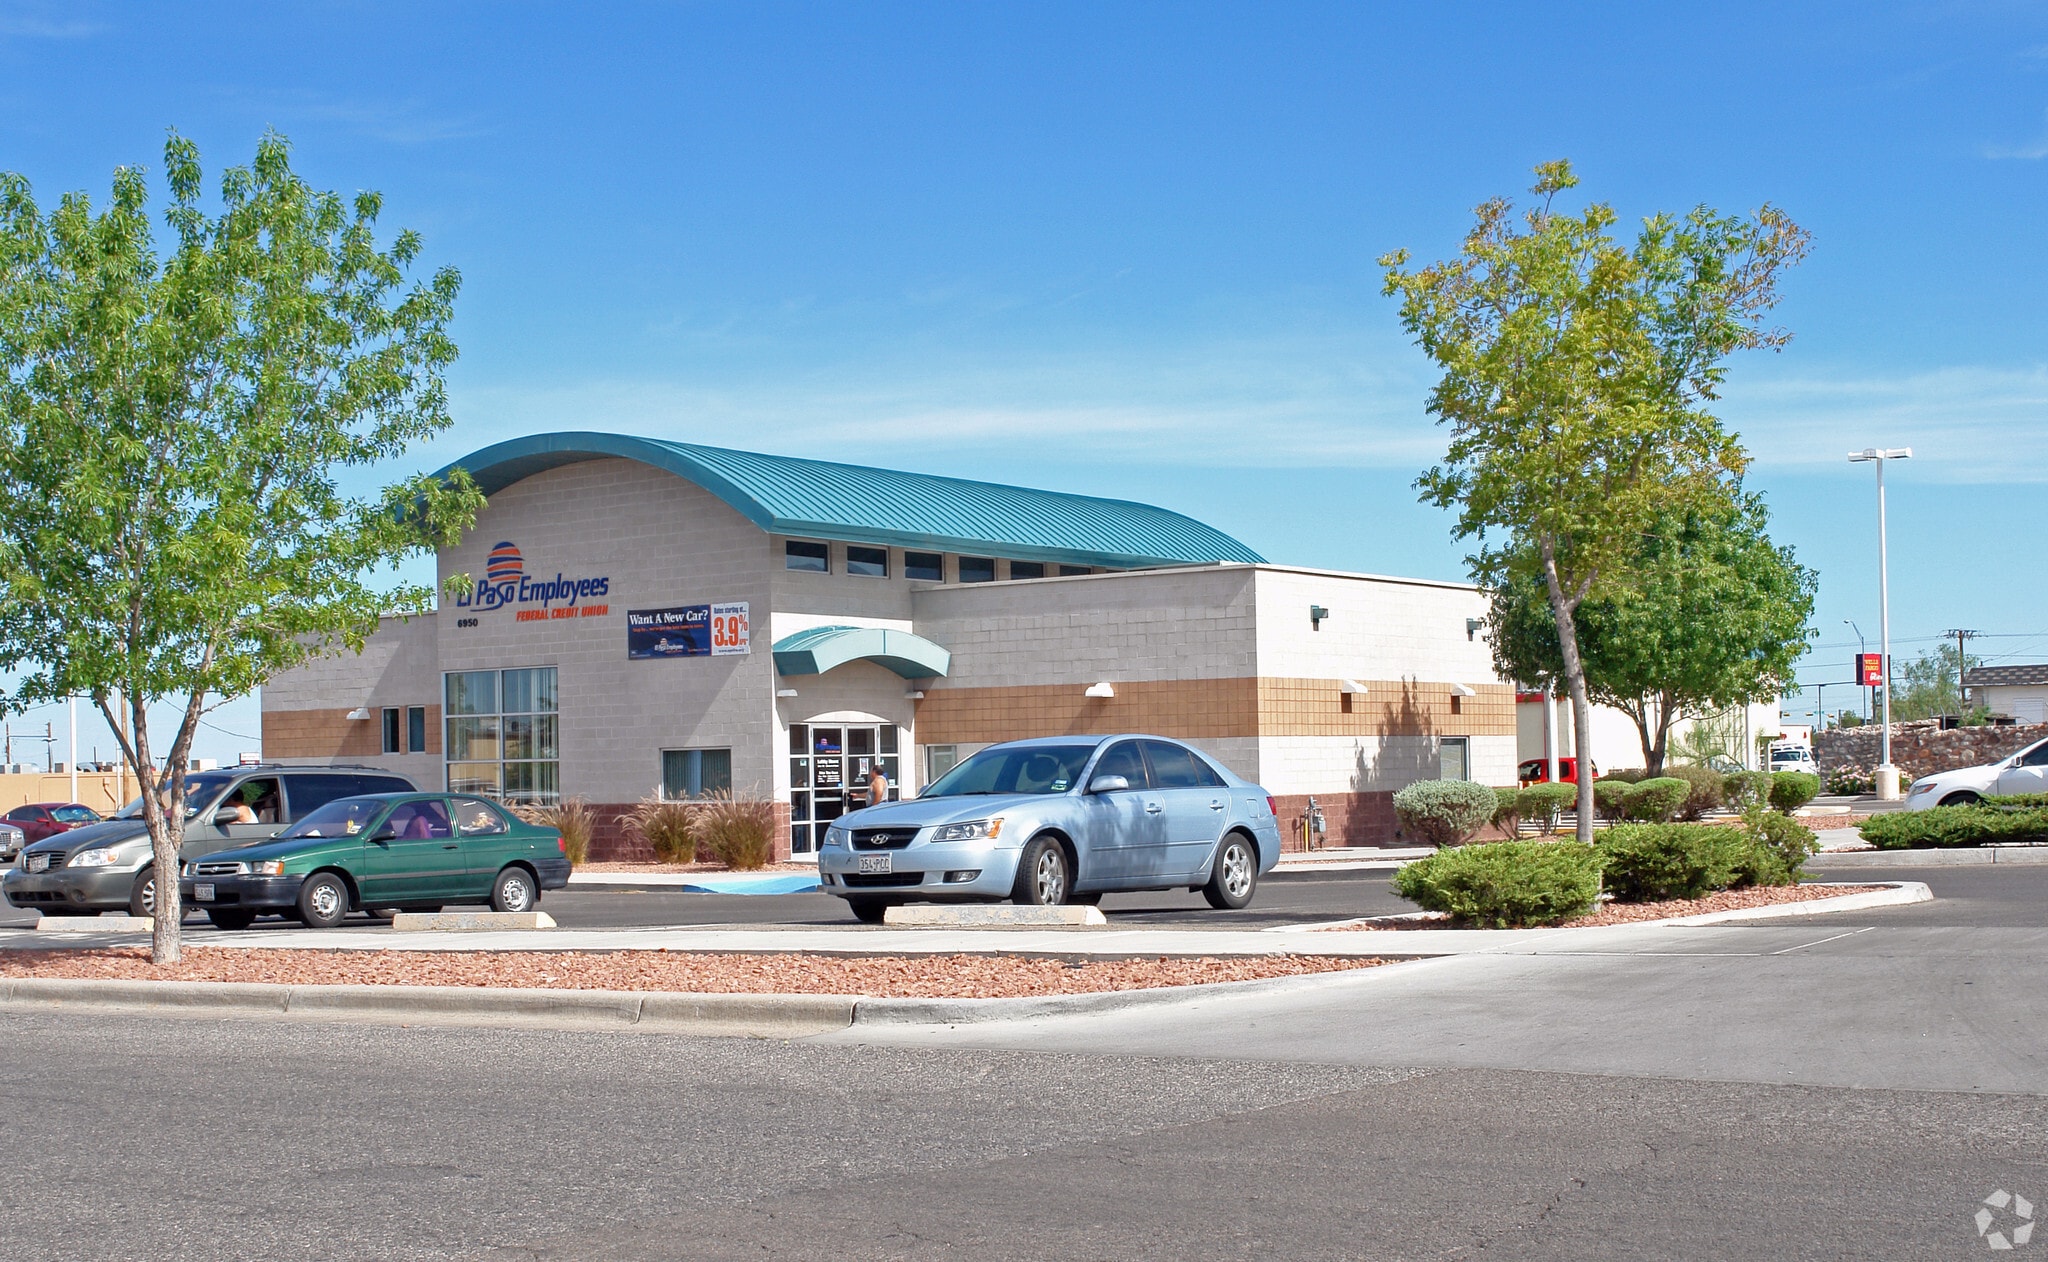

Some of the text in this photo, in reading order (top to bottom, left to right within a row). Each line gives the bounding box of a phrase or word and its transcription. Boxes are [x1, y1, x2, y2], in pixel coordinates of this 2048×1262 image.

[473, 579, 516, 611] Paso
[518, 573, 609, 607] Employees
[516, 604, 609, 622] FEDERAL CREDIT UNION
[629, 609, 709, 625] Want A New Car?
[457, 618, 479, 628] 6950
